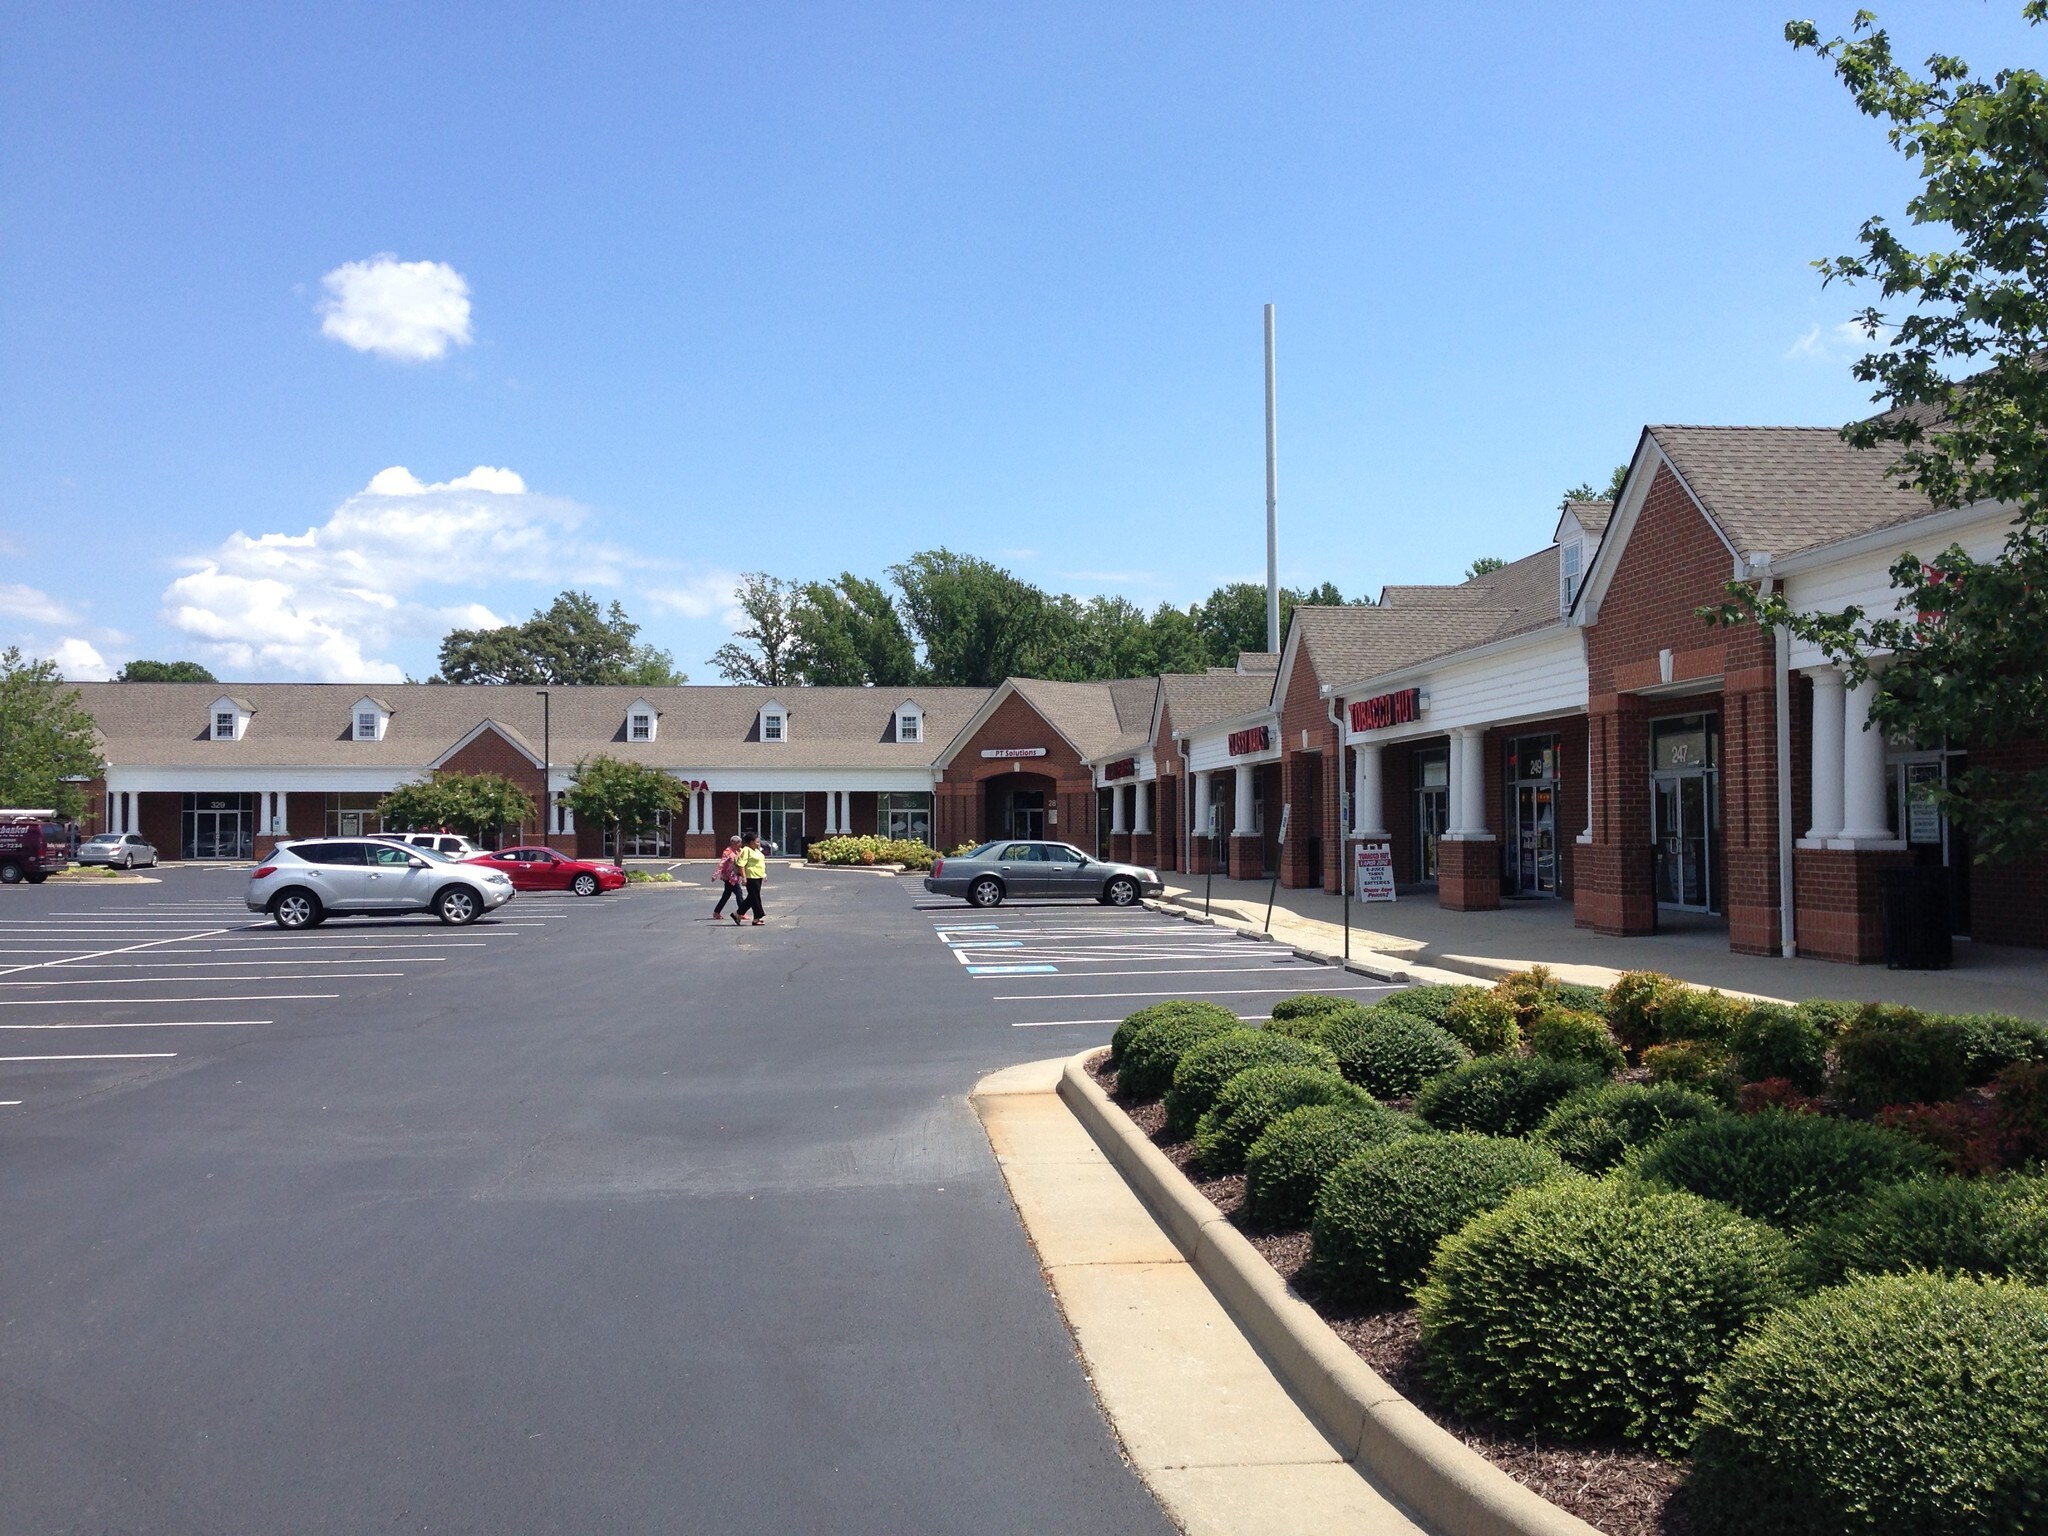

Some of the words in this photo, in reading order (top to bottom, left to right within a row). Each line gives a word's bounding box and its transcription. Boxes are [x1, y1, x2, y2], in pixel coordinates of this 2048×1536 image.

[1348, 694, 1392, 733] TOBACCO
[1394, 688, 1415, 723] HUT
[1005, 749, 1037, 757] Solutions
[1671, 745, 1688, 763] 247
[1530, 760, 1542, 774] 249
[210, 801, 226, 809] 329
[903, 800, 917, 808] 305
